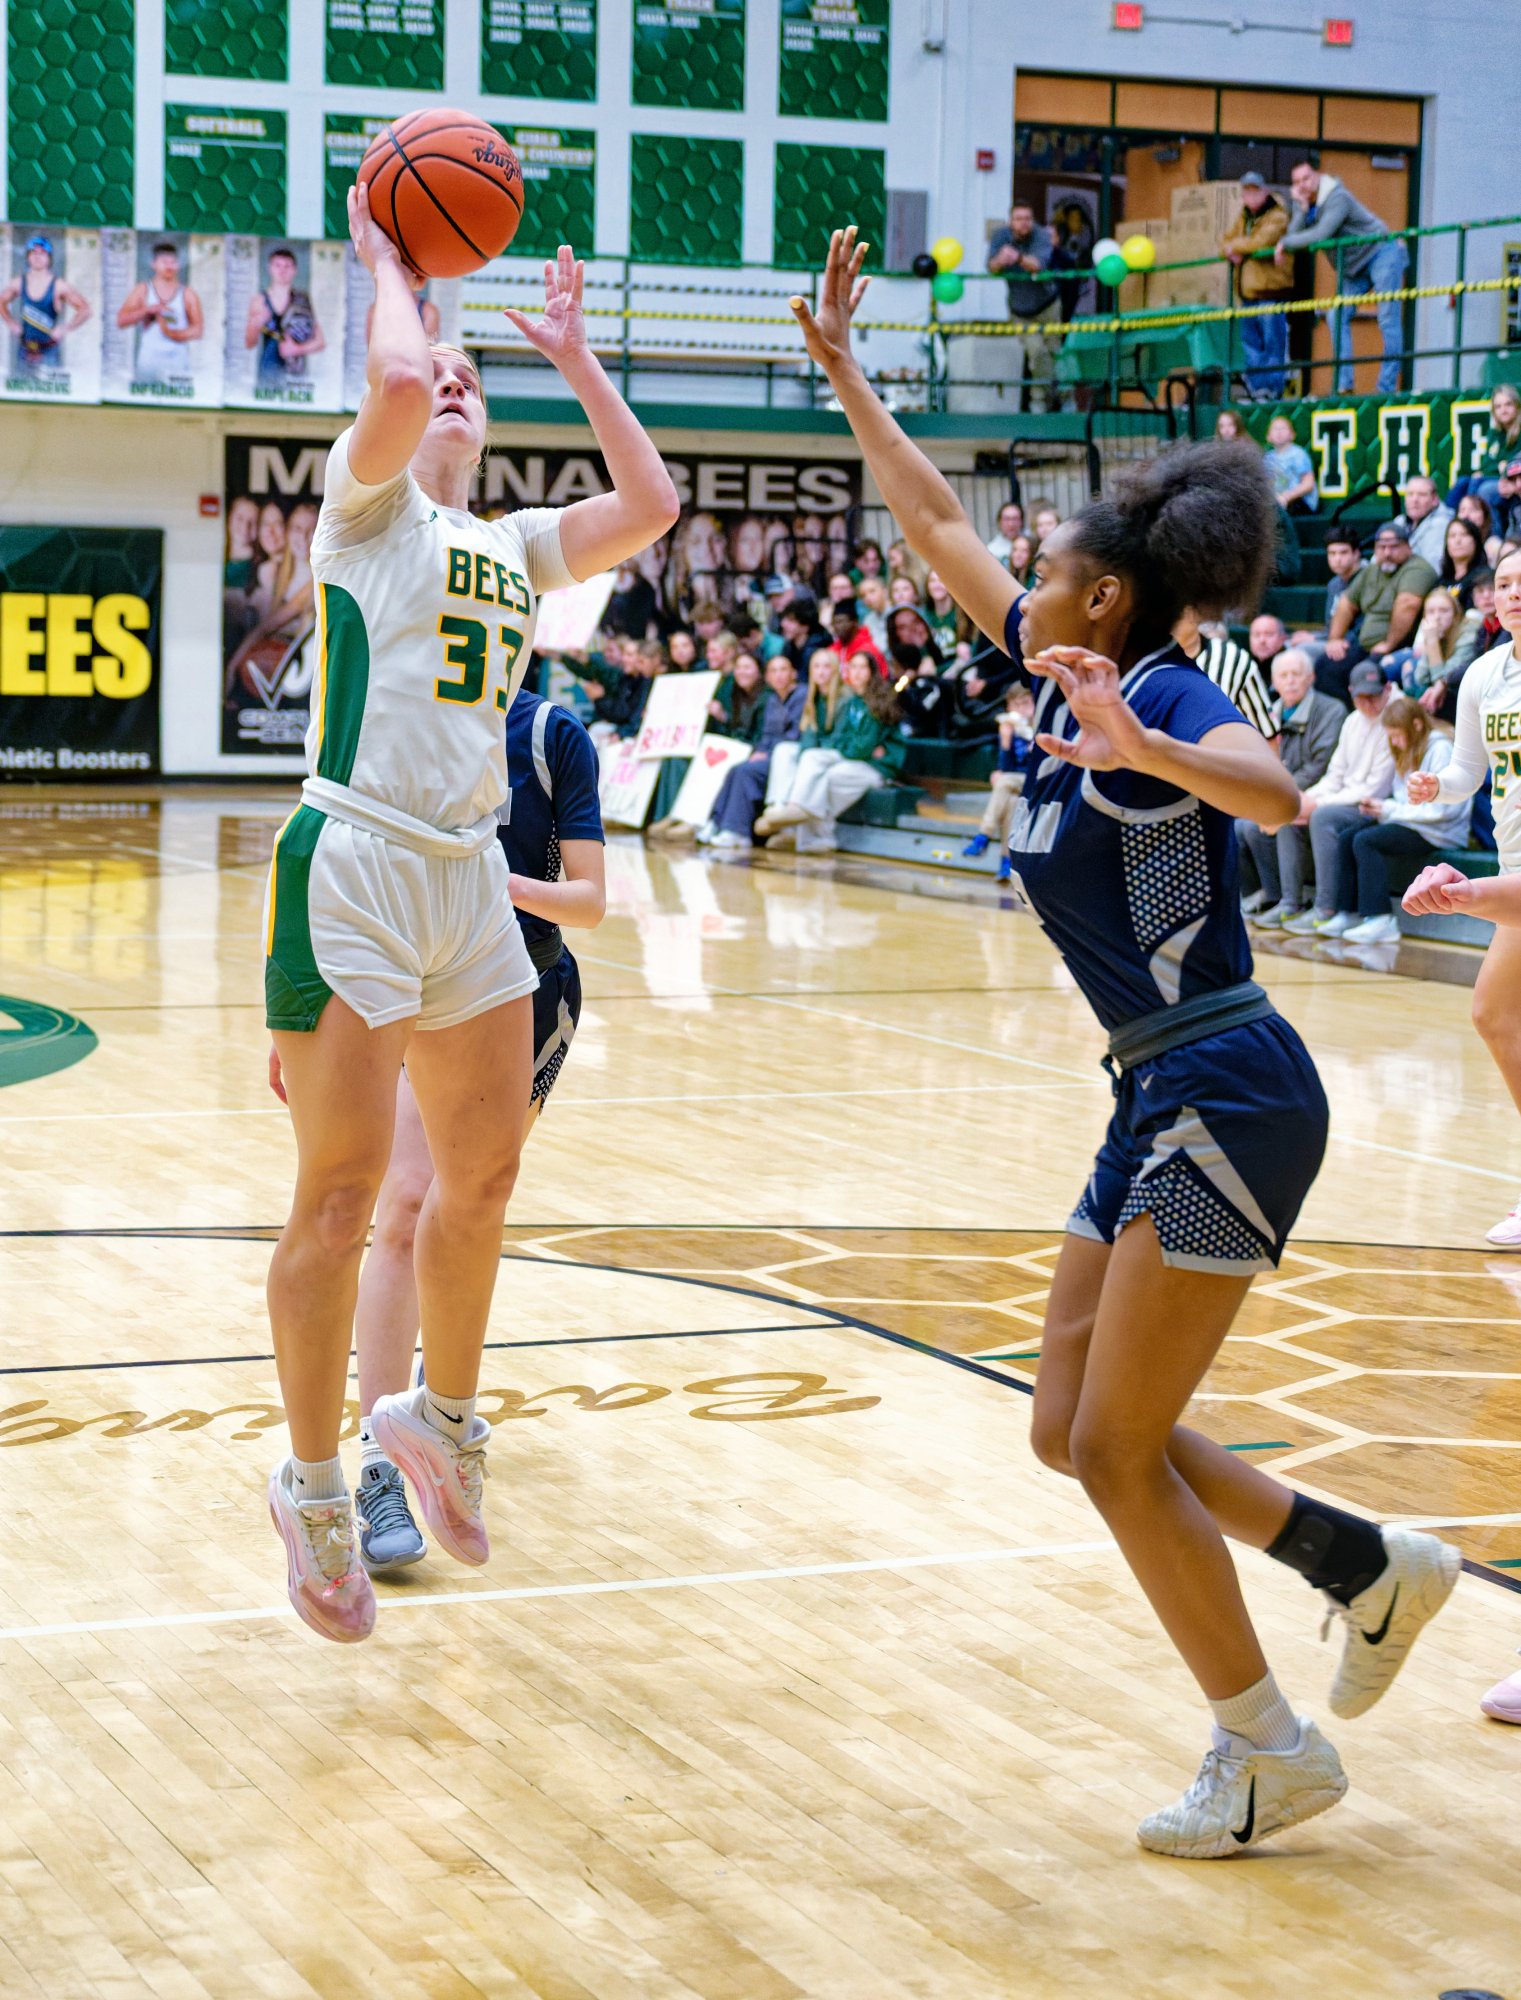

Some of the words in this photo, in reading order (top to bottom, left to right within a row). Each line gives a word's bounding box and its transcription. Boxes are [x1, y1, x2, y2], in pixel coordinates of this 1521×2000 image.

[249, 445, 607, 504] MNA
[447, 546, 531, 617] BEES
[1485, 712, 1521, 743] BEE
[56, 747, 151, 770] Boosters
